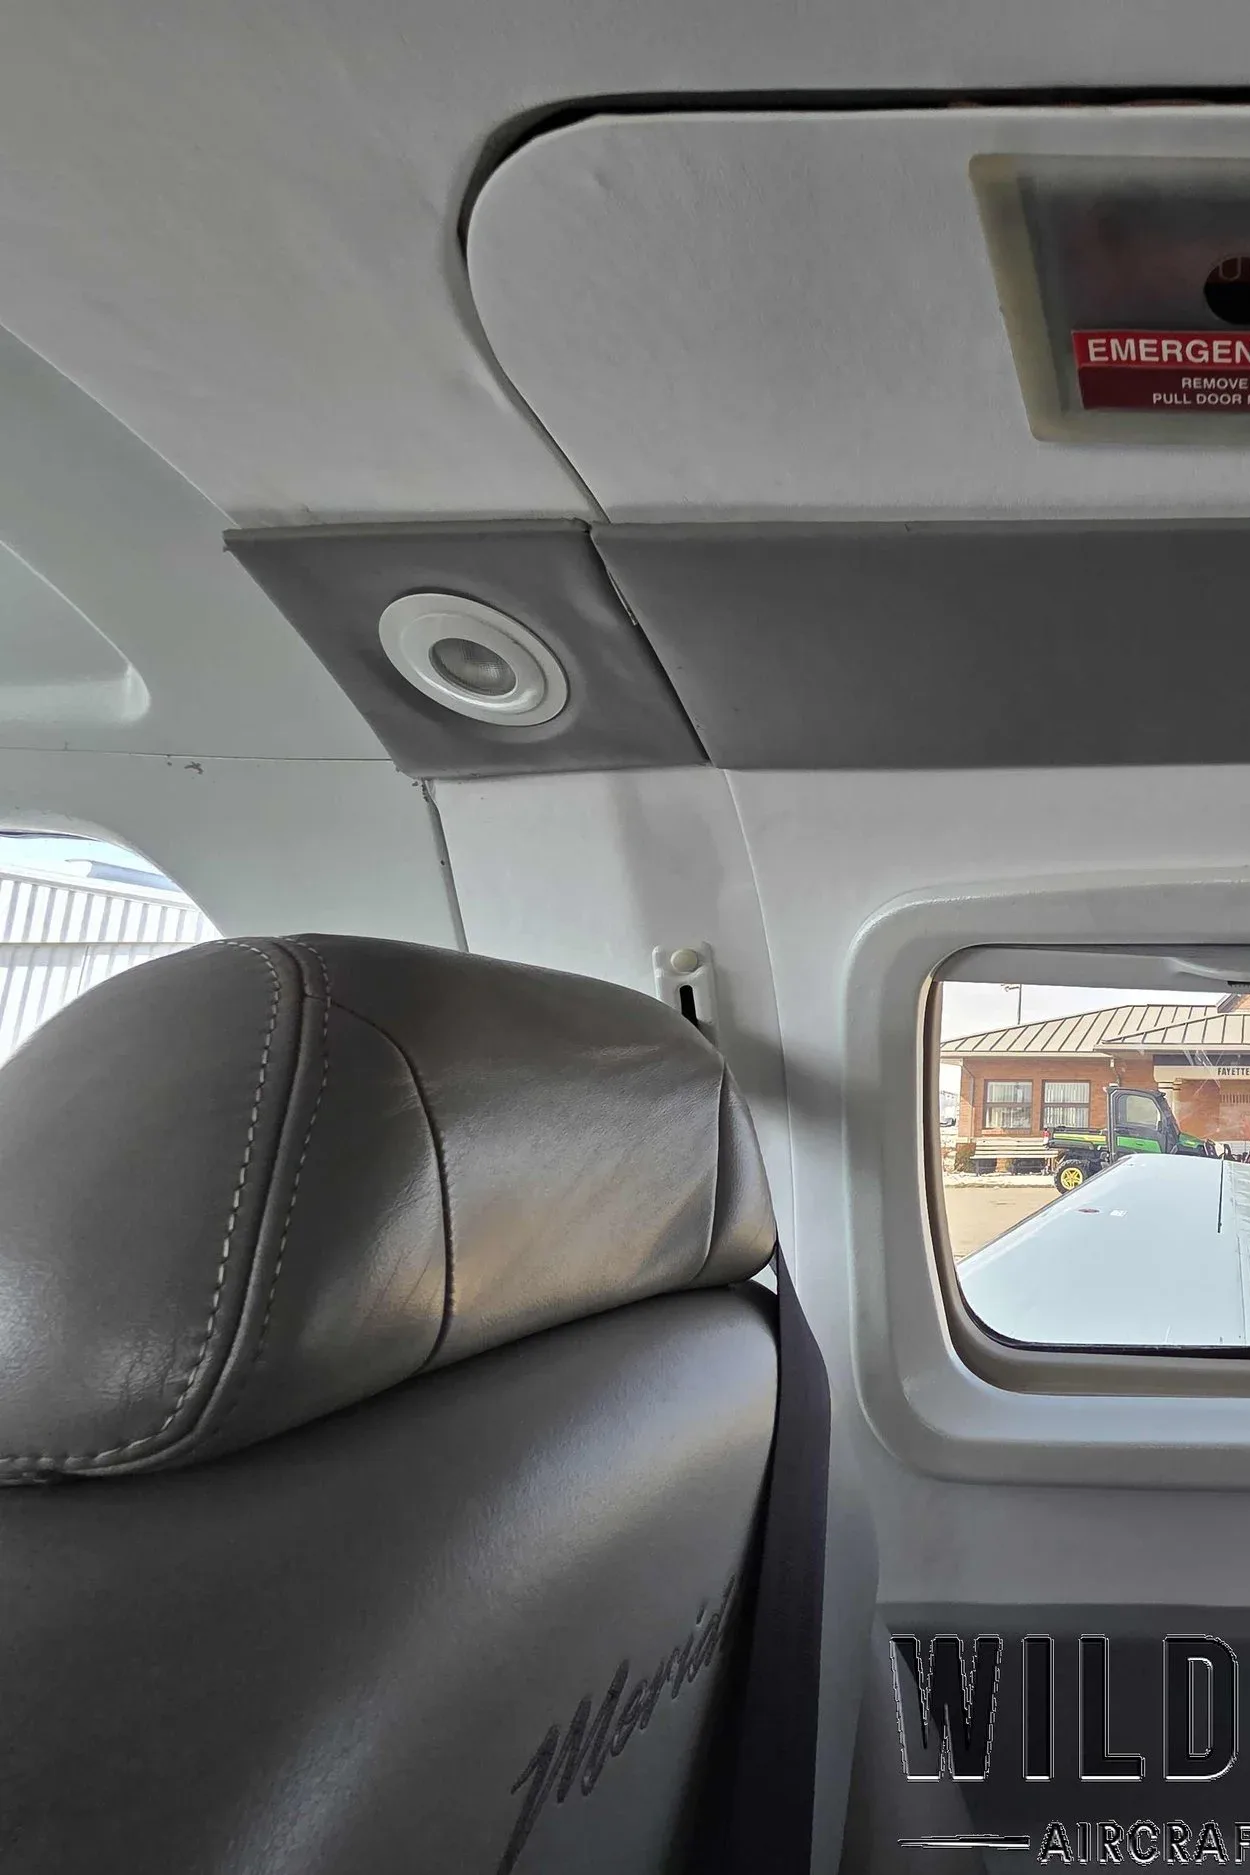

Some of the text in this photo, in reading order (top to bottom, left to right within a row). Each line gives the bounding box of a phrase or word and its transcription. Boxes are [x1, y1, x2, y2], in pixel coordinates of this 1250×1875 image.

[1181, 377, 1248, 391] REMOVE
[1152, 393, 1192, 405] PULL
[1196, 393, 1243, 406] DOOR
[1217, 1067, 1250, 1076] FAYETTE
